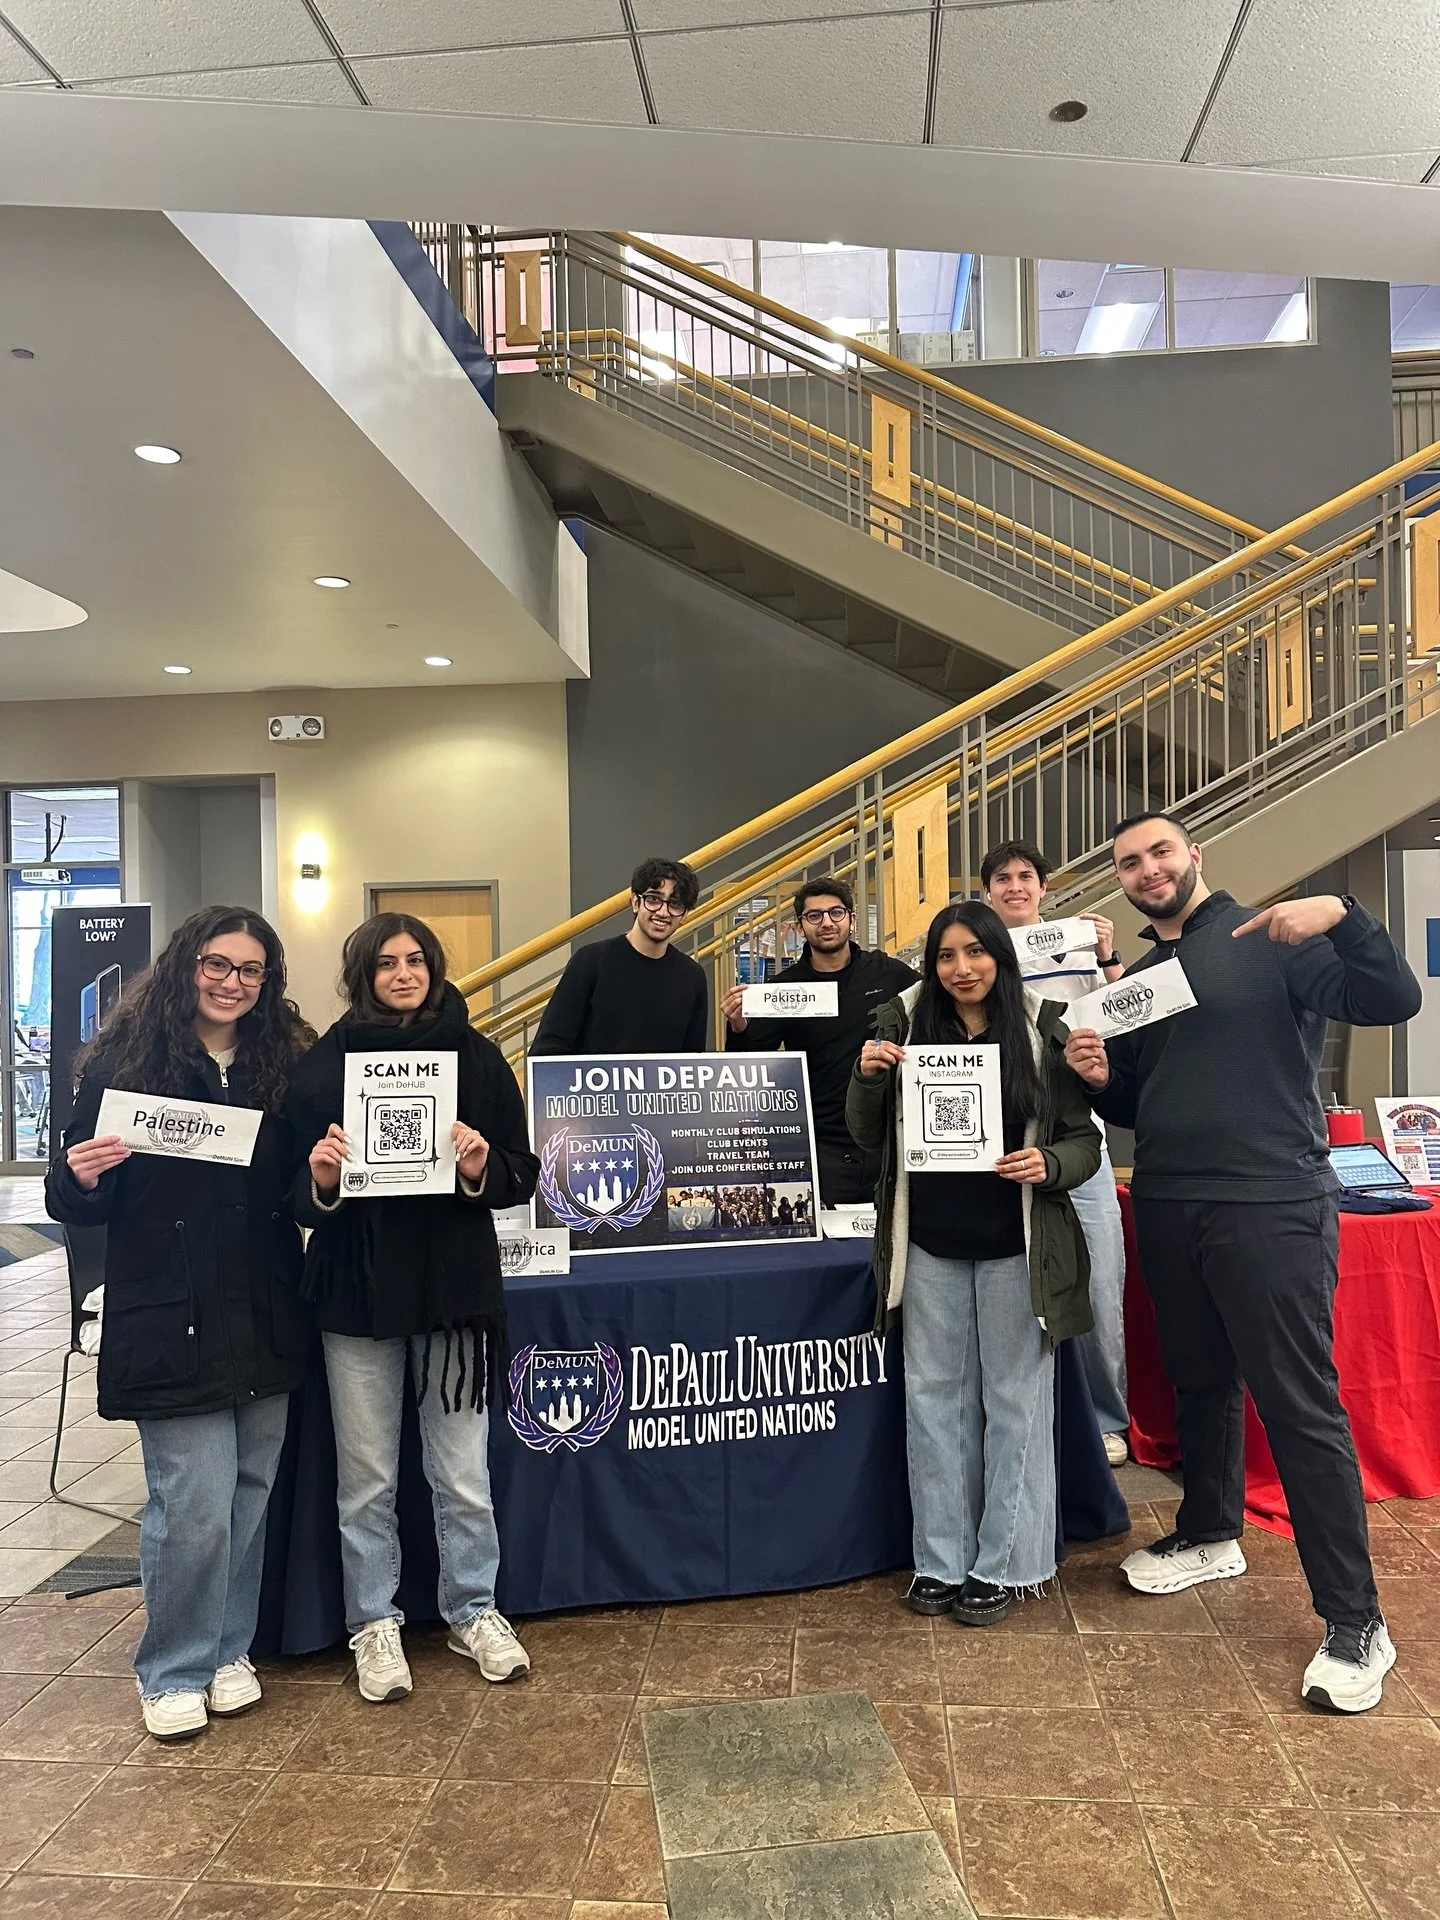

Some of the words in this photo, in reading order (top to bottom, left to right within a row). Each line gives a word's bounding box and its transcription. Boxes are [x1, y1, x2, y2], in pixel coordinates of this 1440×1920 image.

[79, 917, 125, 930] BATTERY
[85, 931, 117, 943] LOW?
[1027, 931, 1064, 945] China
[764, 992, 816, 1003] Pakistan
[1101, 988, 1154, 1016] Mexico
[918, 1055, 957, 1067] SCAN
[963, 1055, 984, 1067] ME
[364, 1063, 409, 1078] SCAN
[416, 1063, 439, 1077] ME
[929, 1070, 974, 1078] INSTAGRAM
[378, 1081, 394, 1089] Join
[396, 1081, 426, 1089] DeHUB
[568, 1066, 645, 1093] JOIN
[658, 1065, 776, 1090] DEPAUL
[546, 1094, 619, 1118] MODEL
[627, 1091, 703, 1115] UNITED
[710, 1089, 799, 1113] NATIONS
[133, 1110, 226, 1137] Palestine
[671, 1128, 714, 1138] MONTHLY
[716, 1127, 740, 1136] CLUB
[741, 1126, 802, 1135] SIMULATIONS
[162, 1136, 189, 1145] UNHRC
[568, 1137, 635, 1154] DeMUN
[707, 1140, 731, 1148] CLUB
[733, 1138, 768, 1148] EVENTS
[706, 1151, 743, 1161] TRAVEL
[744, 1150, 770, 1159] TEAM
[671, 1164, 694, 1174] JOIN
[695, 1163, 714, 1173] OUR
[715, 1162, 774, 1173] CONFERENCE
[776, 1161, 805, 1170] STAFF
[511, 1242, 556, 1256] Africa
[533, 1355, 597, 1370] DeMUN
[628, 1416, 690, 1450] MODEL
[694, 1406, 758, 1445] UNITED
[762, 1400, 837, 1436] NATIONS
